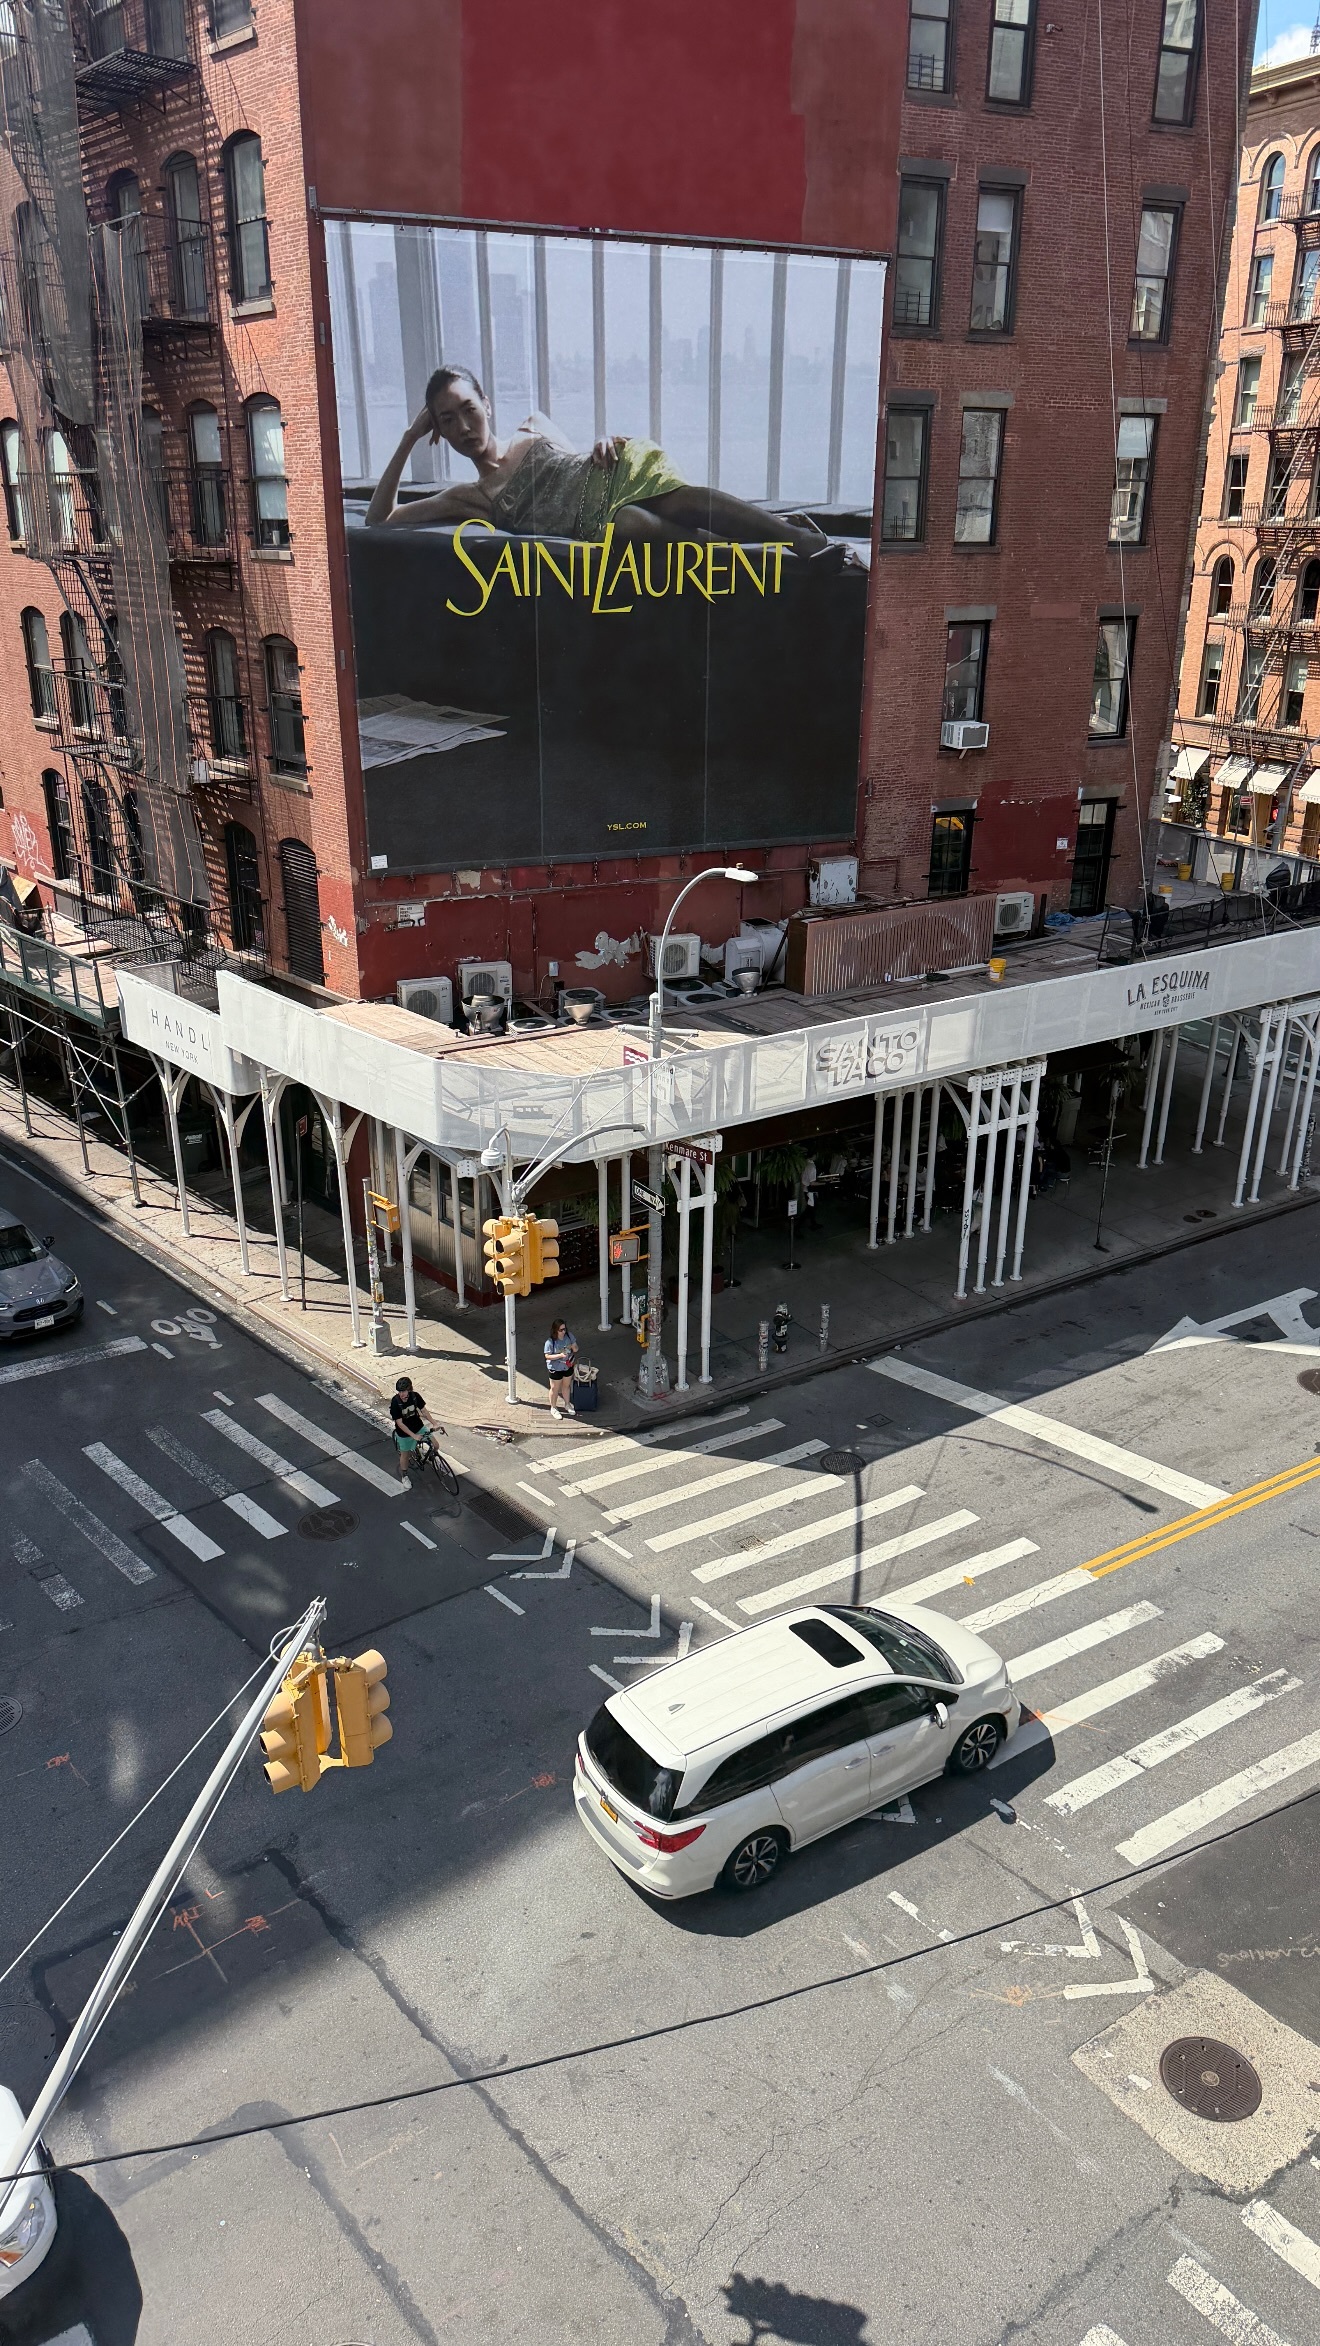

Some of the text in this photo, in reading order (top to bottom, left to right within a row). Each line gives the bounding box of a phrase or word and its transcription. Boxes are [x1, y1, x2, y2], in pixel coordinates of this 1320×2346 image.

[606, 821, 647, 831] YSL.COM
[1127, 970, 1210, 1006] LA ESQUINA
[165, 1041, 180, 1053] NEW
[816, 1027, 920, 1064] SANTO
[817, 1048, 907, 1087] TACO
[665, 1141, 708, 1162] Kenmare St
